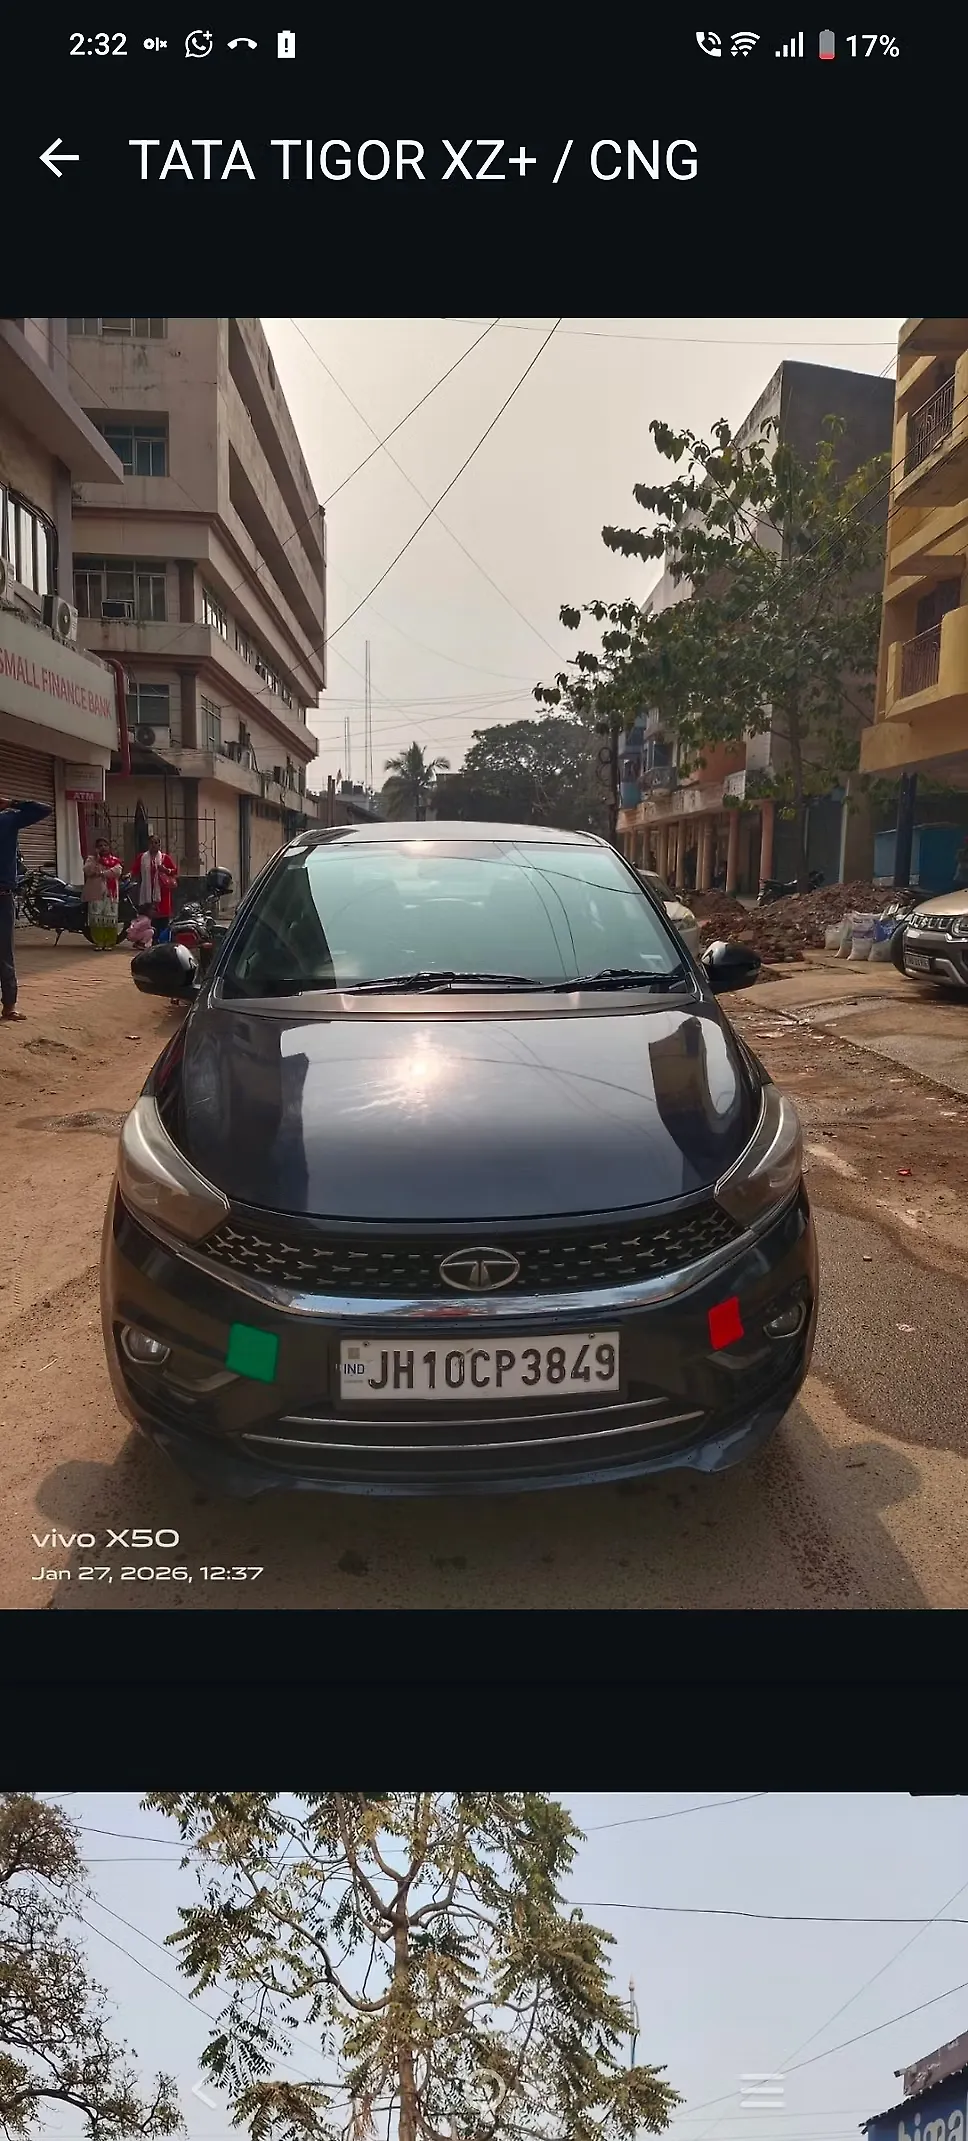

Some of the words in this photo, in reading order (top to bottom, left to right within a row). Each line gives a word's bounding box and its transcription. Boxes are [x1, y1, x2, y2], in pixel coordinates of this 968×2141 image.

[69, 32, 128, 56] 2:32
[846, 34, 900, 58] 17%
[129, 139, 256, 180] TATA
[271, 139, 426, 181] TIGOR
[441, 139, 537, 181] XZ+
[552, 139, 574, 184] /
[590, 139, 698, 181] CNG
[42, 667, 87, 710] FINANCE
[88, 691, 112, 719] BANK
[73, 792, 94, 801] ATM
[343, 1363, 366, 1375] IND
[367, 1343, 616, 1390] JH10CP3849
